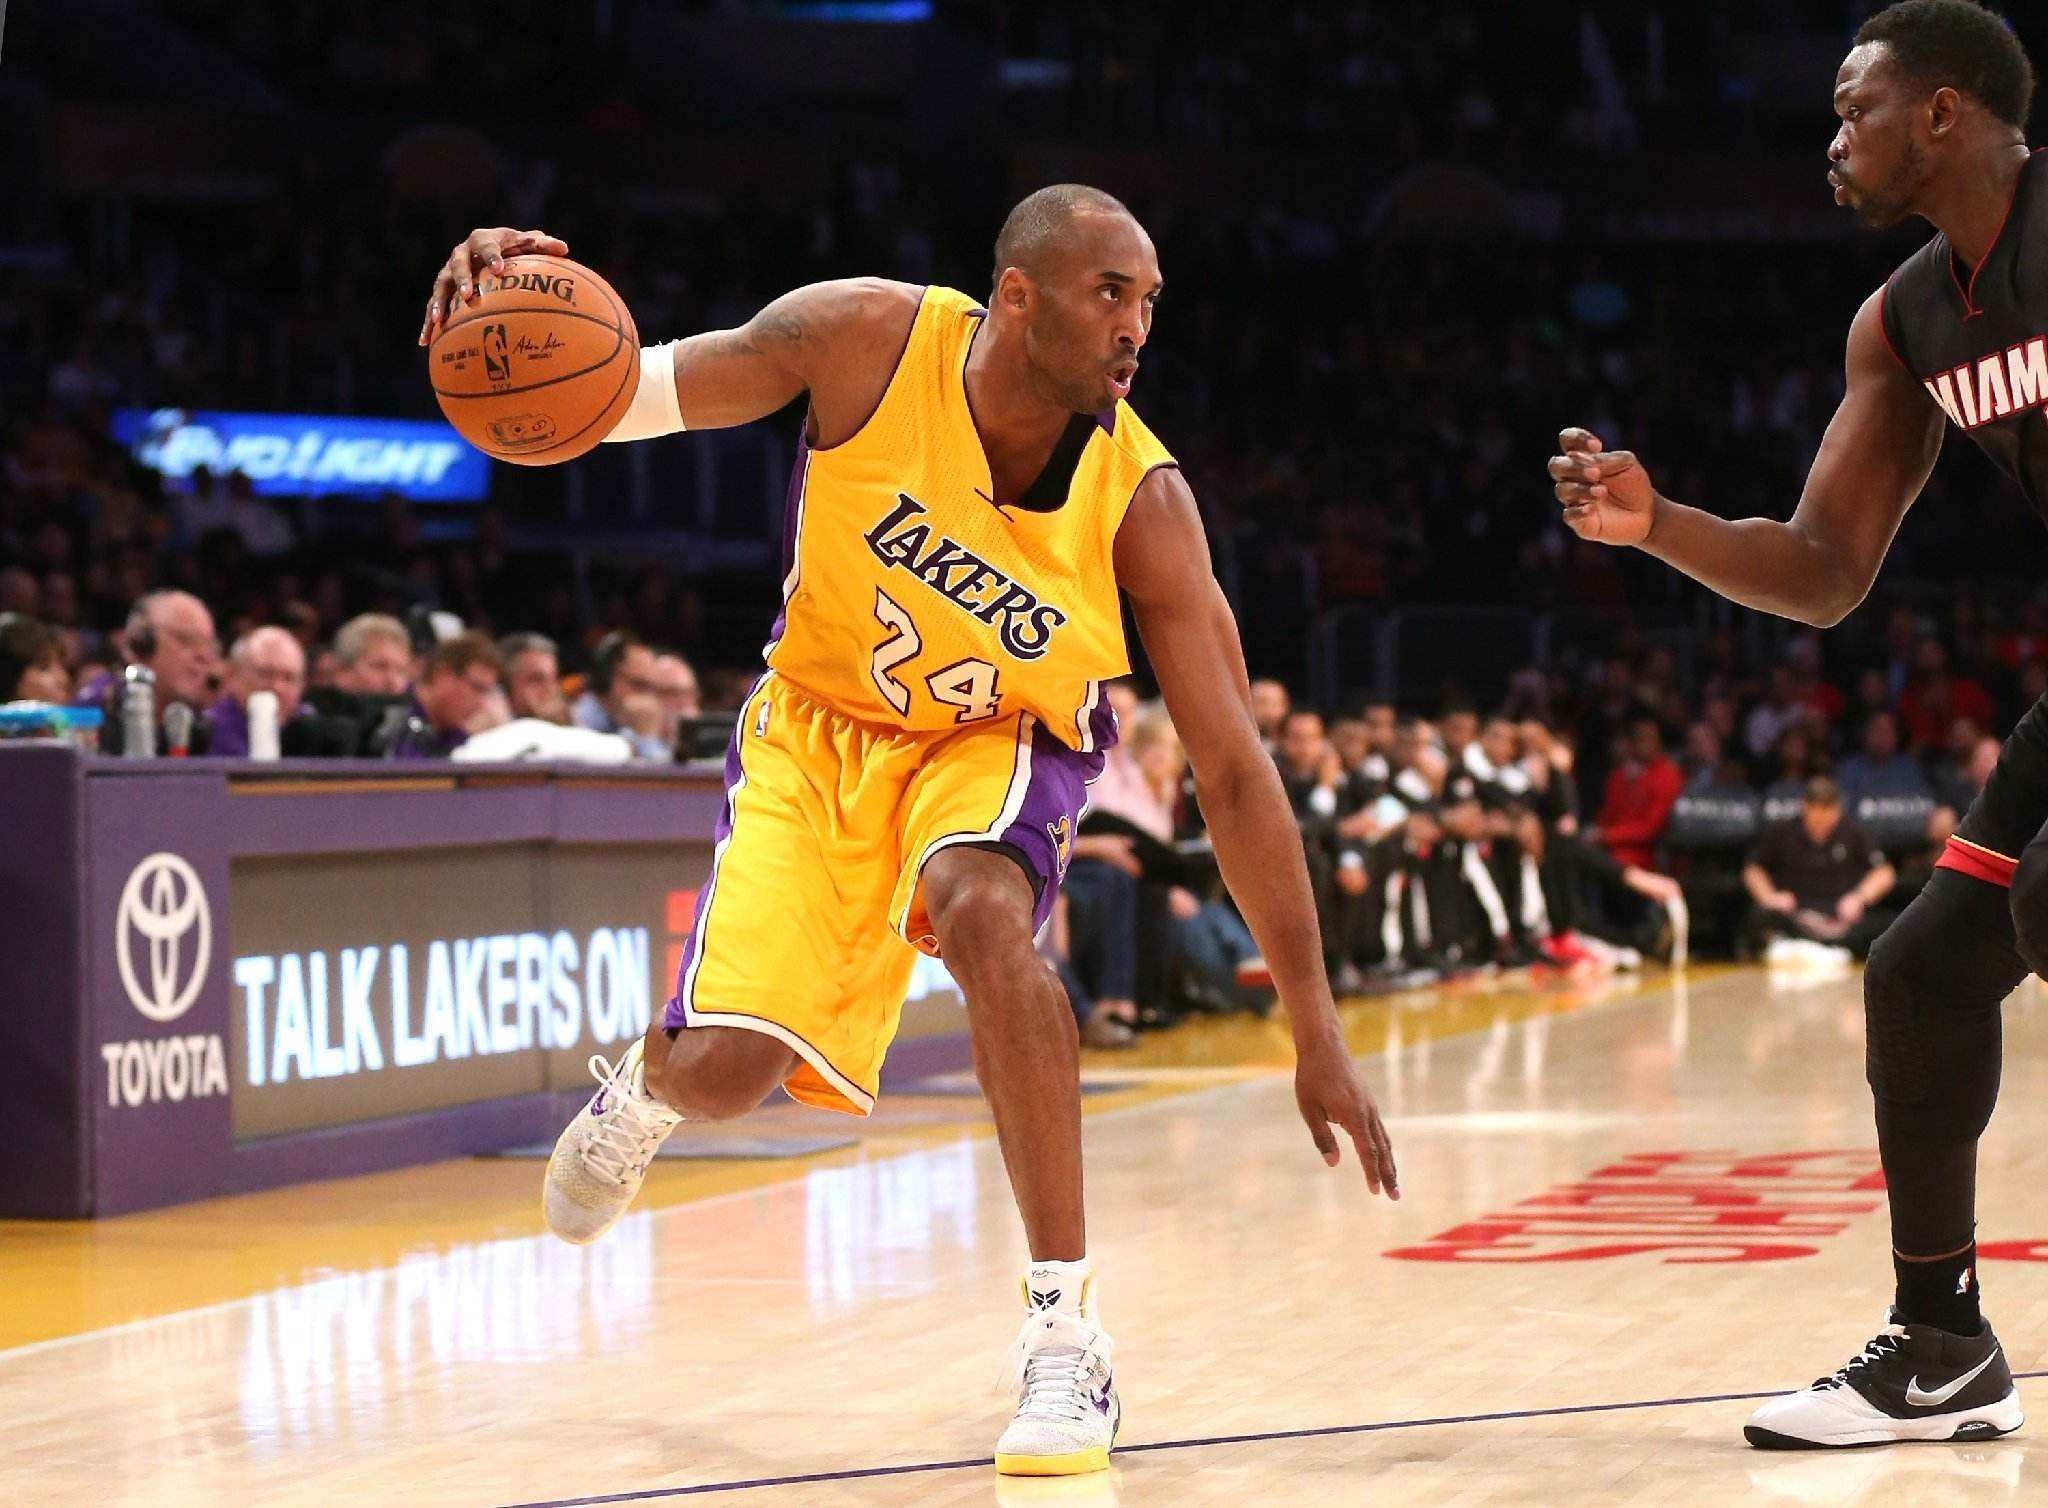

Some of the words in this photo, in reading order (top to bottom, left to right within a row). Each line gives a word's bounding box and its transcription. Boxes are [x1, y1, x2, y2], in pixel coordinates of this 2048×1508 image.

[450, 272, 577, 312] ALDING
[864, 492, 1067, 663] LAKERS
[869, 584, 1002, 724] 24
[102, 1035, 229, 1108] TOYOTA
[234, 945, 382, 1086] TALK
[391, 932, 580, 1066] LAKERS
[585, 926, 652, 1044] ON
